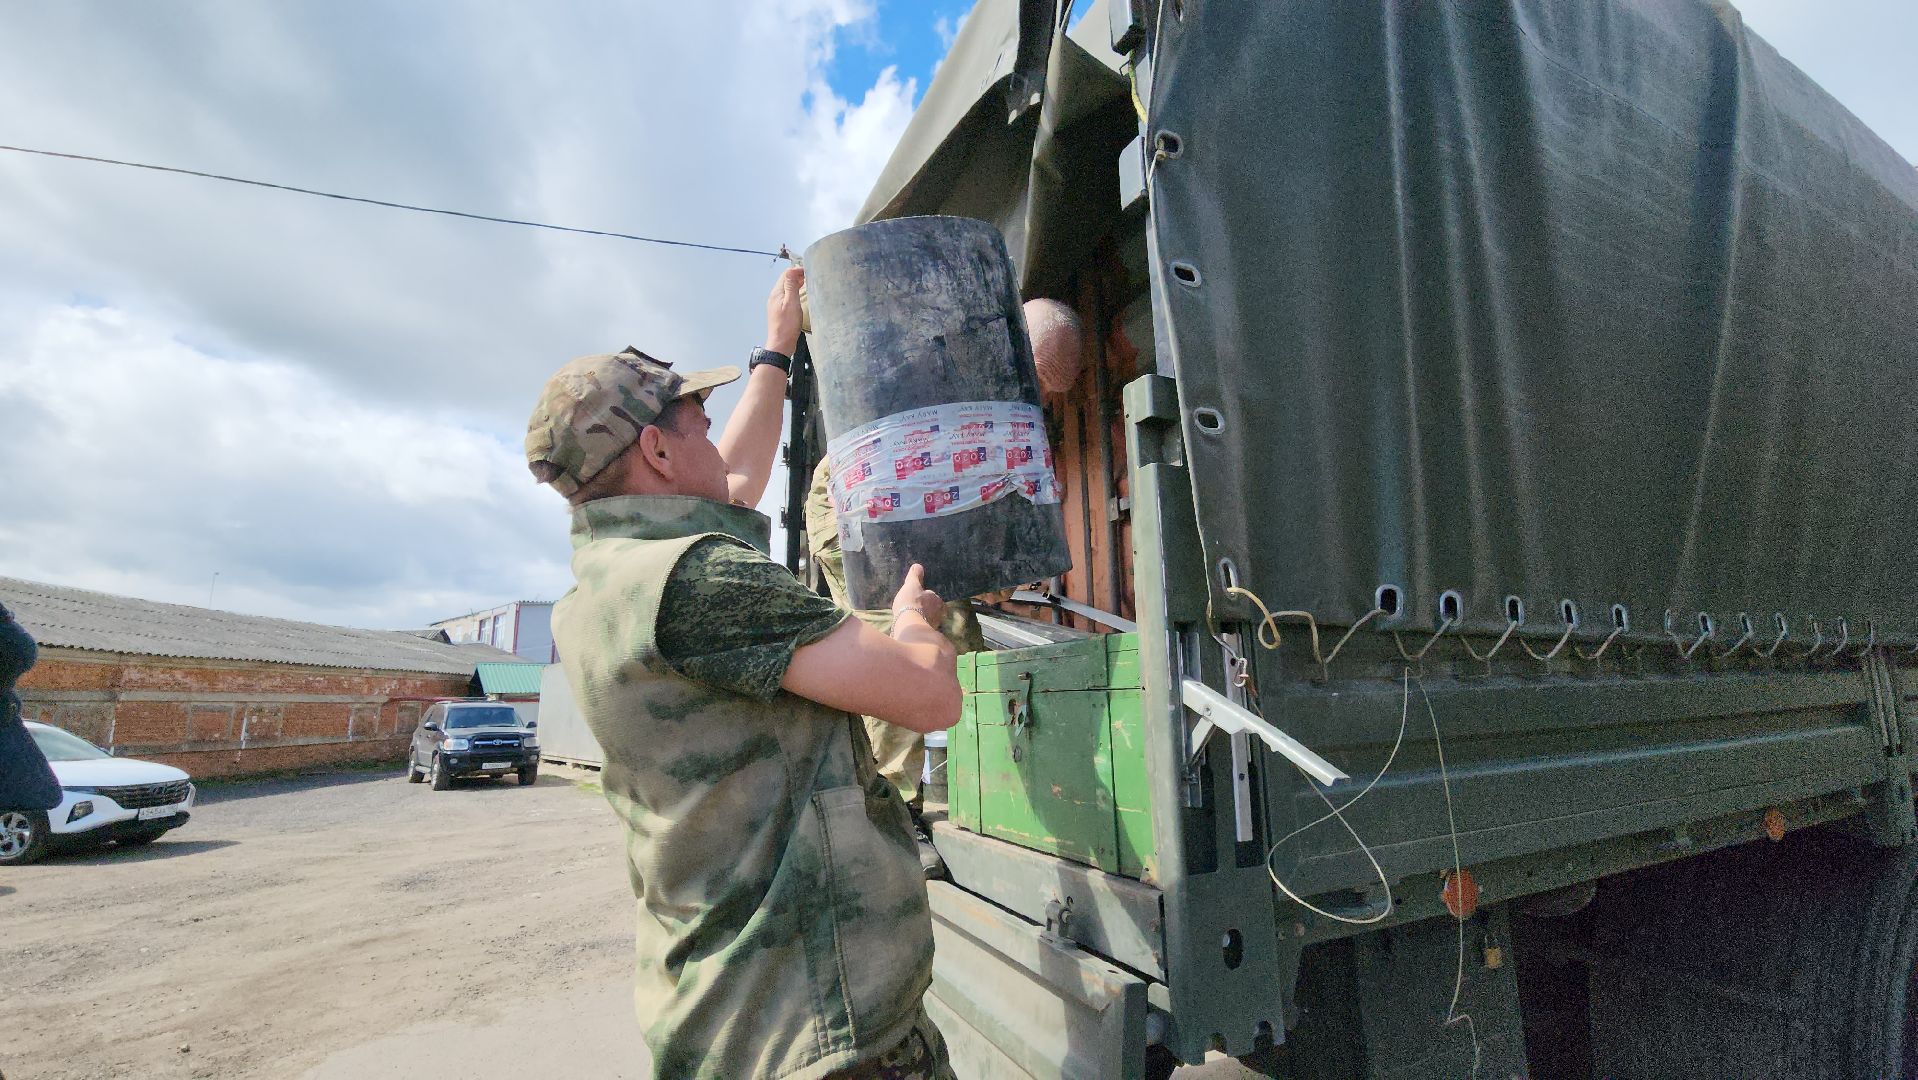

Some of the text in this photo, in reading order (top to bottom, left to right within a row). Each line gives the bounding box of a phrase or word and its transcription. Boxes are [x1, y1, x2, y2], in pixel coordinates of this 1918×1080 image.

[901, 409, 939, 422] MARY KAY
[895, 456, 932, 470] 2020
[953, 451, 986, 463] 2020
[924, 490, 959, 504] 2020
